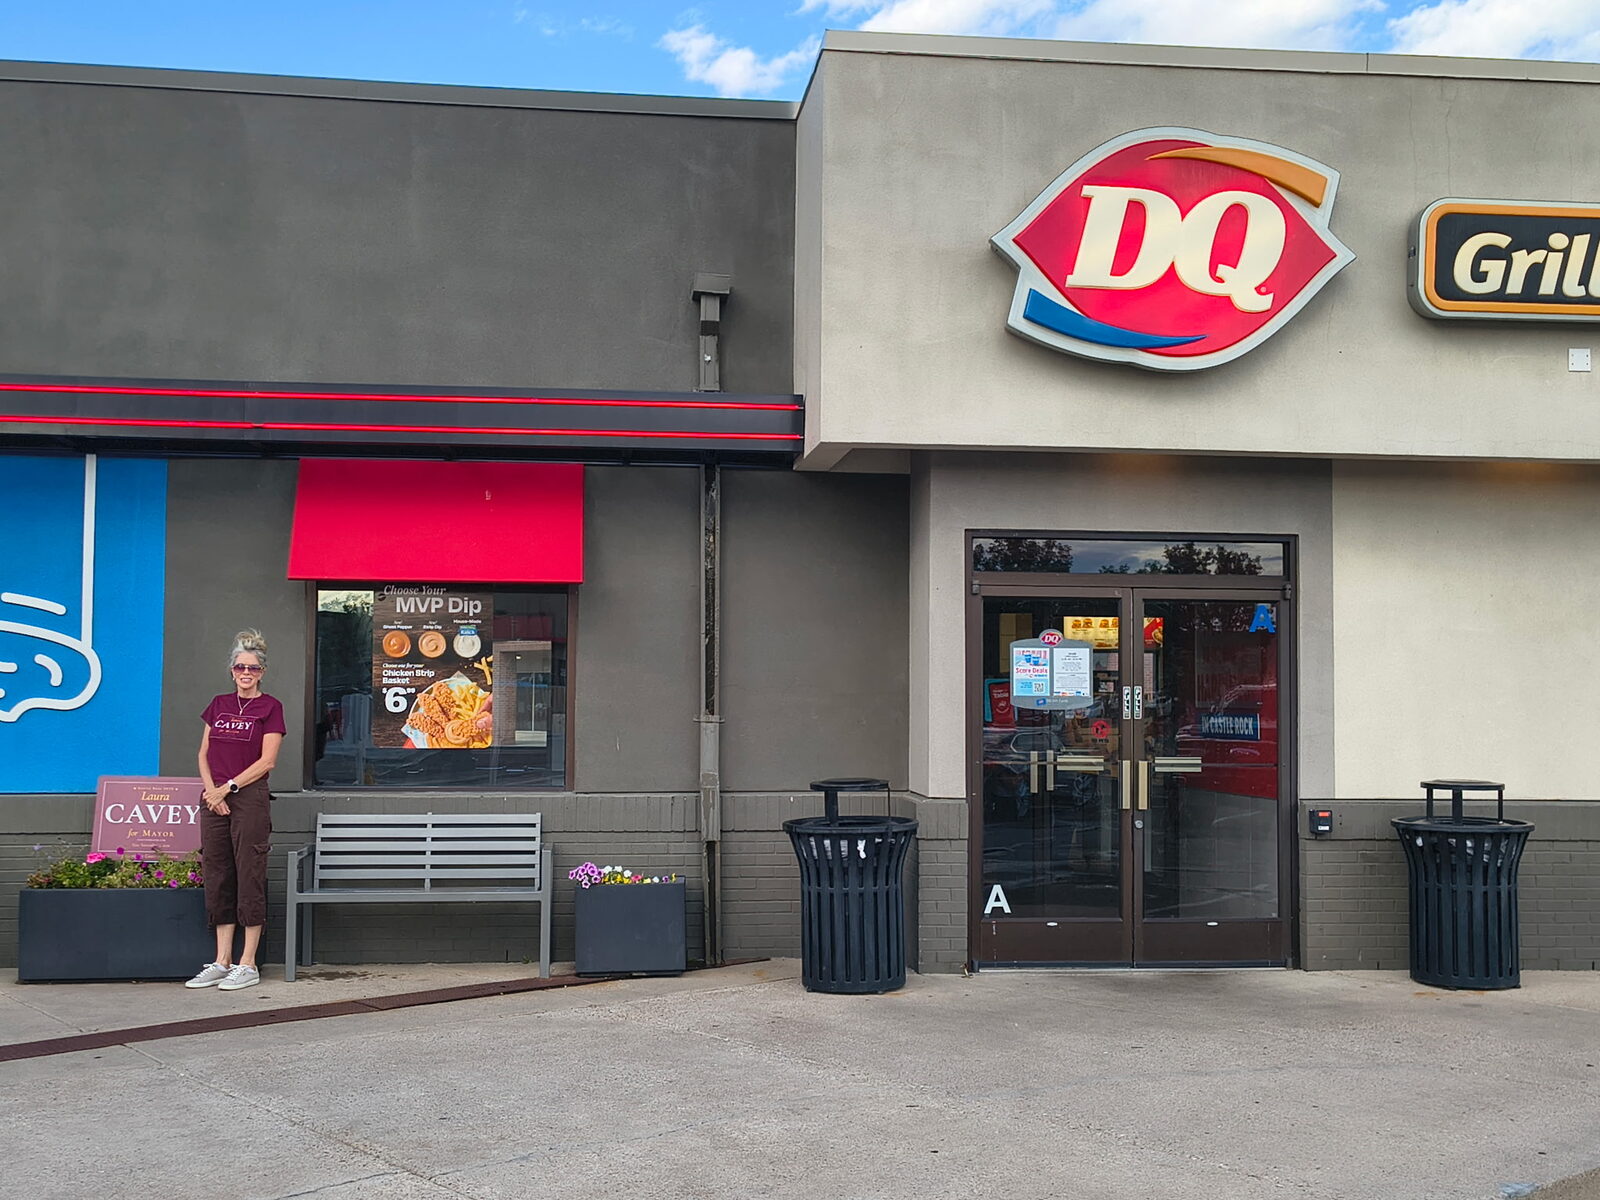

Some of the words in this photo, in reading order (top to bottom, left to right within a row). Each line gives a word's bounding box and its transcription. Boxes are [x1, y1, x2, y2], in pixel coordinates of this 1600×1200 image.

[1066, 185, 1287, 313] DQ
[384, 585, 419, 595] Choose
[422, 585, 446, 595] Your
[396, 597, 443, 613] MVP
[448, 597, 482, 616] Dip
[1249, 604, 1276, 632] A
[1044, 634, 1059, 642] DQ
[415, 670, 435, 678] Strip
[214, 719, 252, 730] CAVEY
[1209, 716, 1234, 734] CASTLE
[1234, 717, 1254, 735] ROCK
[141, 791, 170, 801] Laura
[105, 803, 200, 825] CAVEY
[127, 828, 138, 838] for
[983, 884, 1012, 914] A
